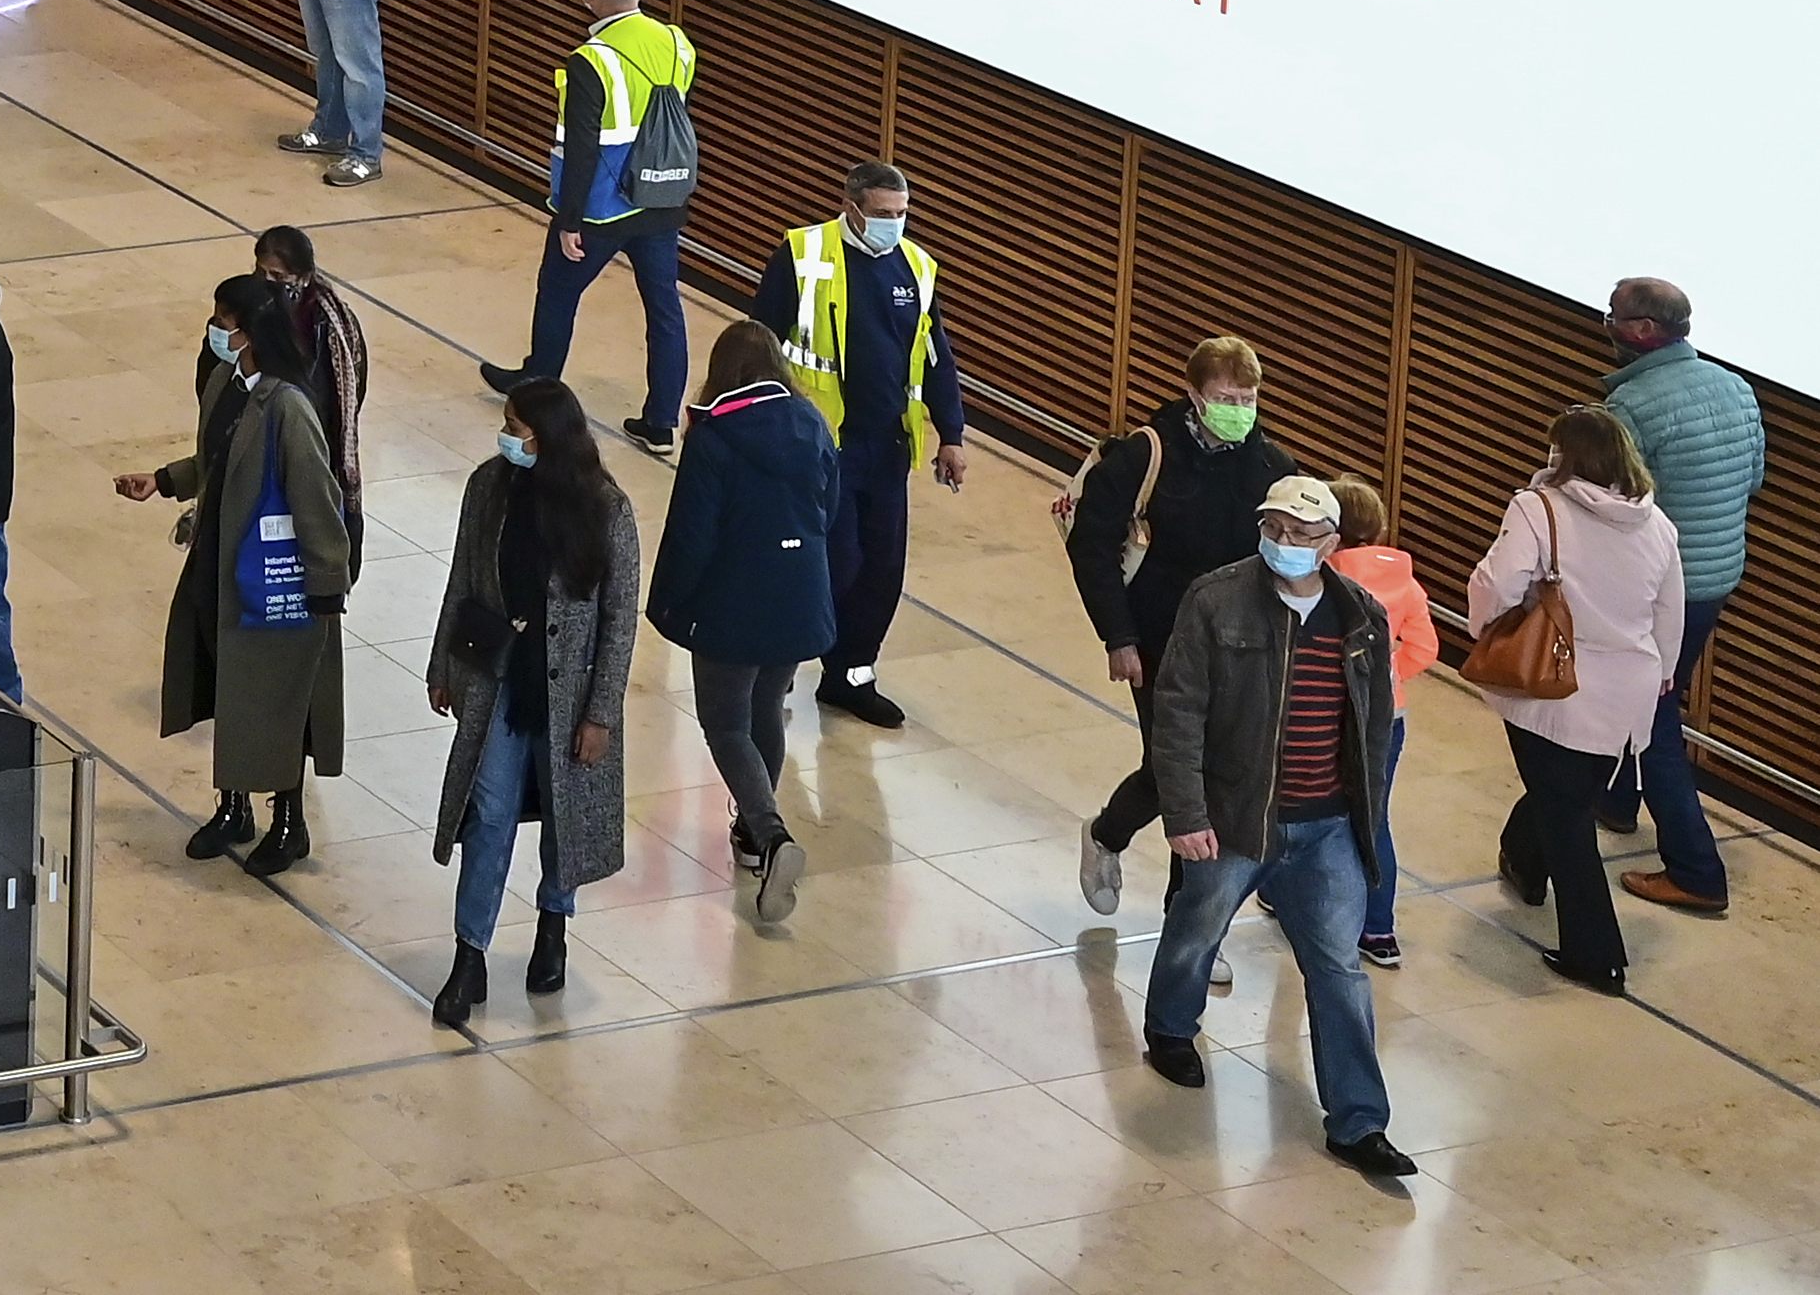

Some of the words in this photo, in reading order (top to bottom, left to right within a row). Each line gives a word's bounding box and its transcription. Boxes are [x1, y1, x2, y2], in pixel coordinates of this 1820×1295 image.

[265, 567, 292, 576] Forum
[266, 595, 285, 604] ONE
[266, 605, 284, 614] ONE
